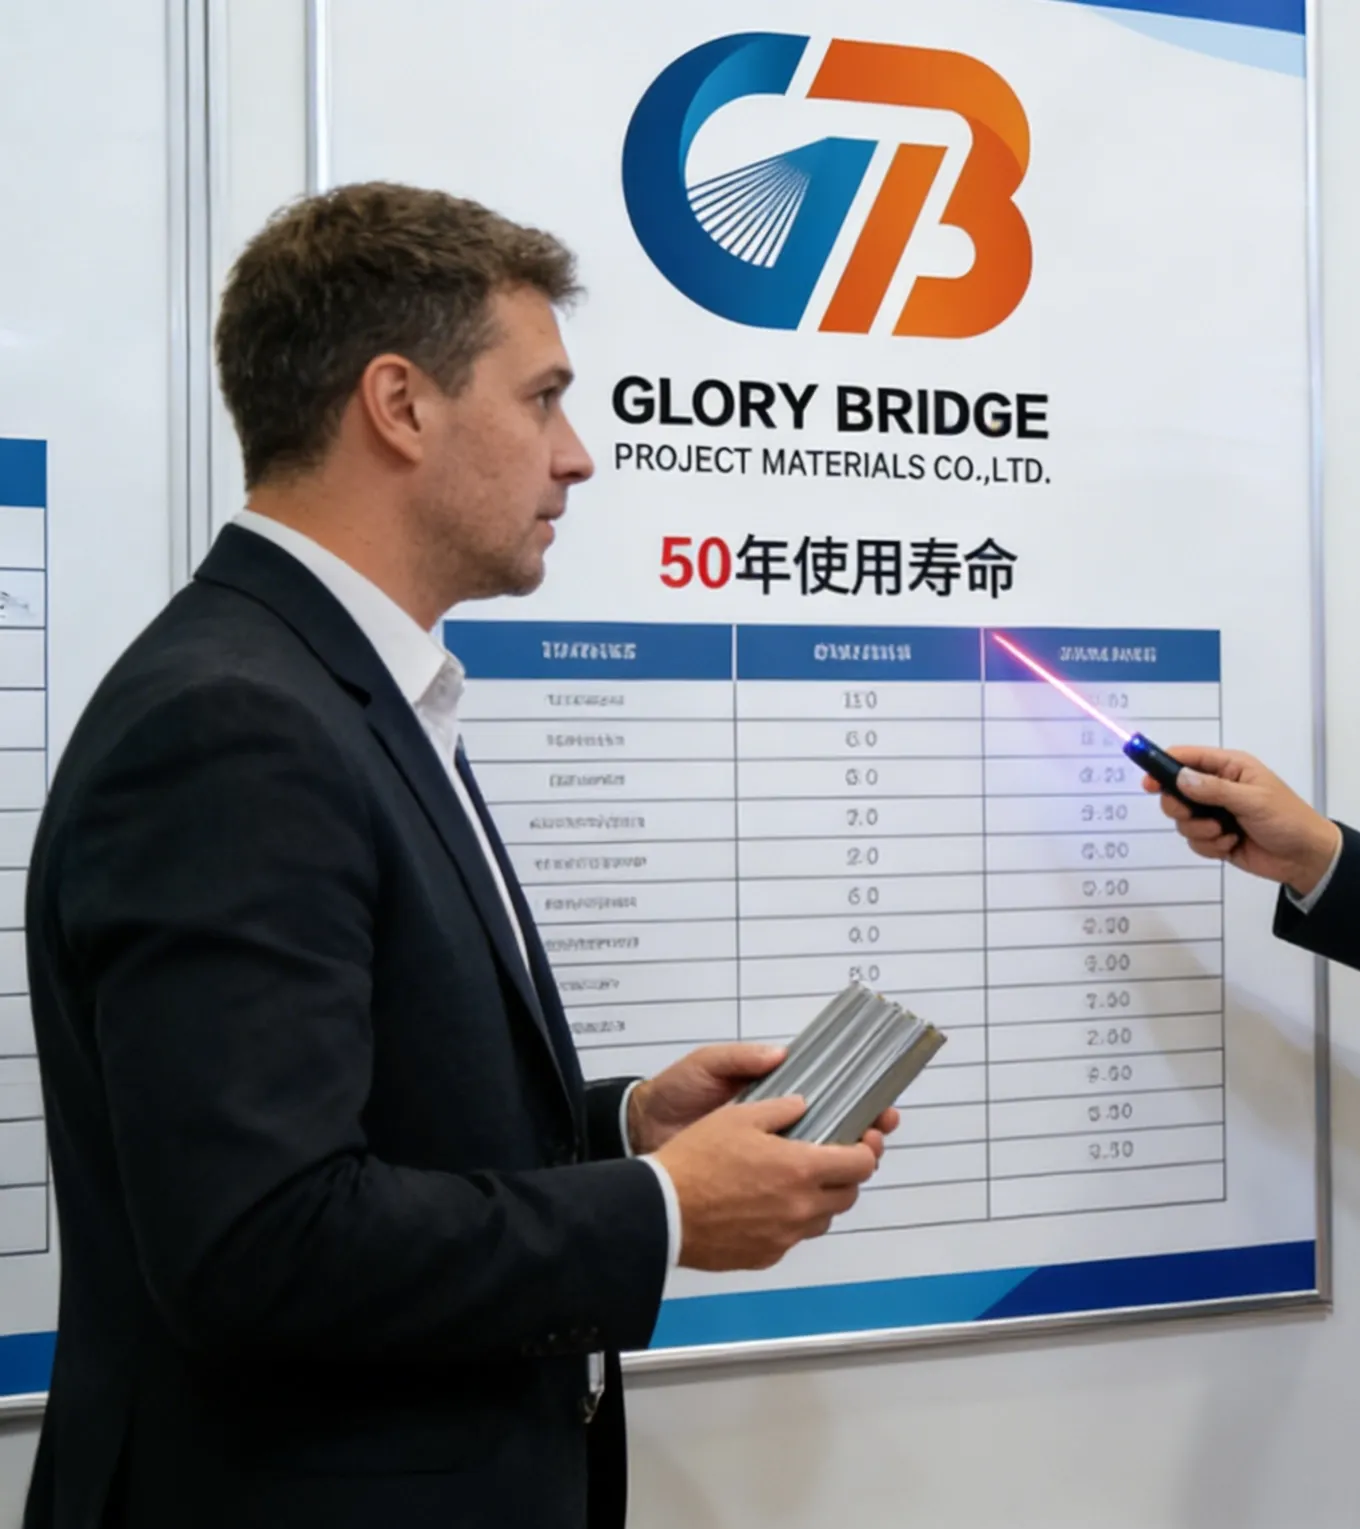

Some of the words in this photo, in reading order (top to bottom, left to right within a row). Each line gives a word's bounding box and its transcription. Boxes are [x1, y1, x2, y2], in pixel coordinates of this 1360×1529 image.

[612, 375, 819, 429] GLORY
[837, 385, 1049, 439] BRIDGE
[615, 442, 752, 474] PROJECT
[762, 448, 925, 480] MATERIALS
[934, 454, 1051, 486] CO.,LTD.
[660, 534, 1018, 599] 50年使用寿命
